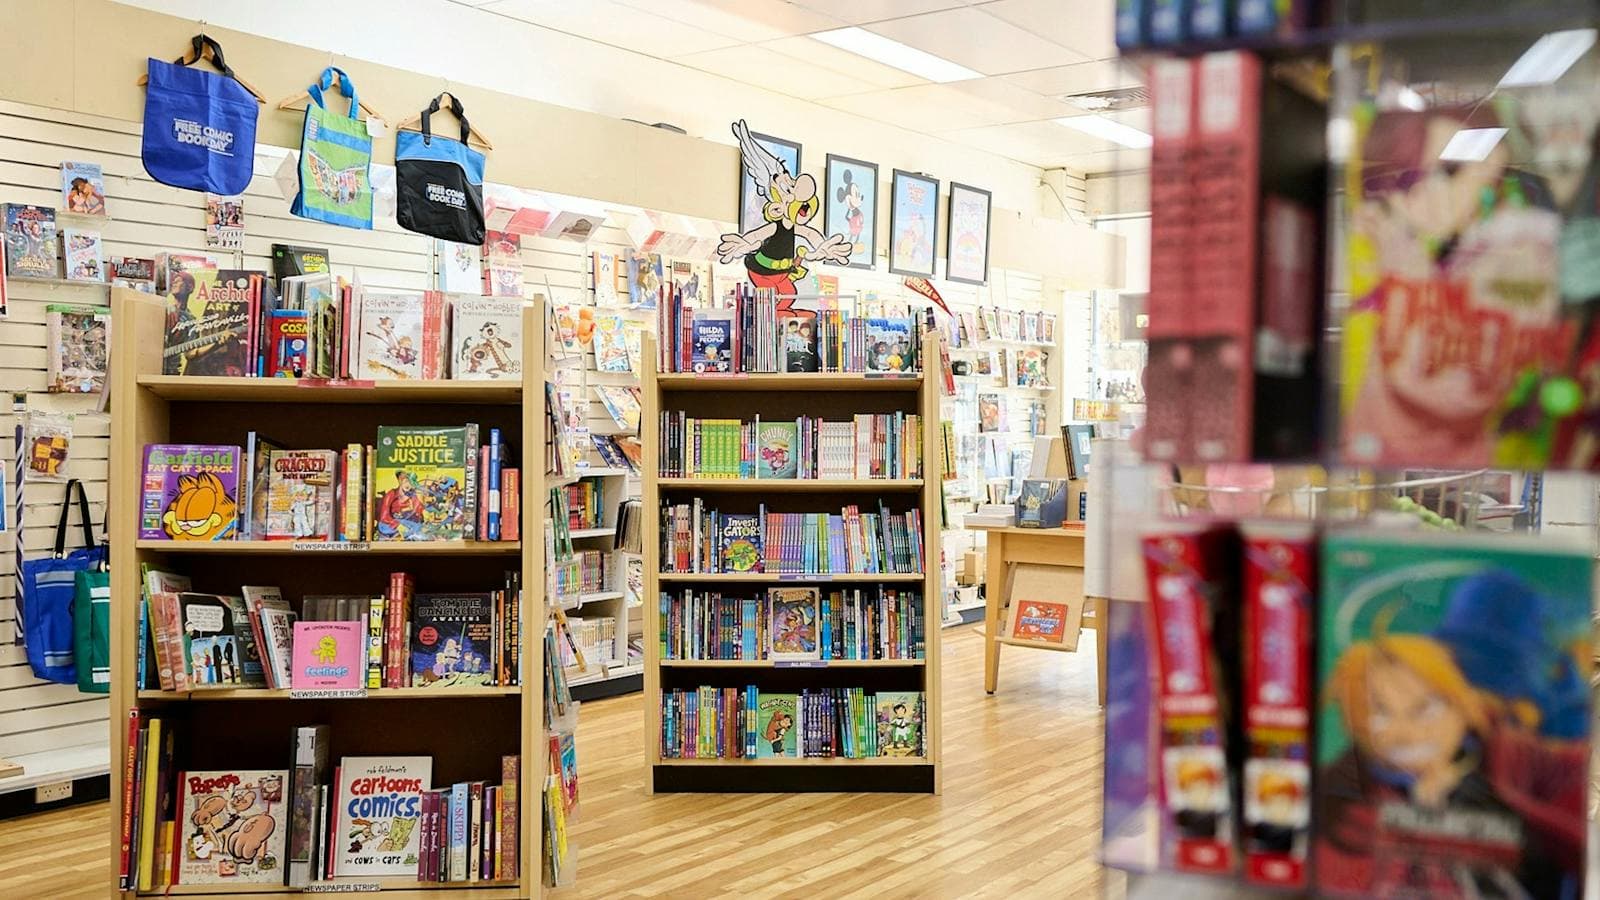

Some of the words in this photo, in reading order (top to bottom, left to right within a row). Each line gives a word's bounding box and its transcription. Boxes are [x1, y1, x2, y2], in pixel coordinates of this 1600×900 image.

[174, 121, 201, 135] FREE
[203, 126, 233, 143] COMIC
[178, 132, 210, 147] BOOK
[427, 185, 446, 195] FREE
[429, 193, 451, 203] BOOK
[207, 303, 231, 312] ART
[699, 326, 725, 334] HILDA
[760, 426, 793, 442] CHUNKY
[396, 435, 448, 447] SADDLE
[149, 450, 233, 465] Garfield
[388, 448, 455, 463] JUSTICE
[147, 464, 168, 473] FAT
[170, 464, 192, 473] CAT
[195, 464, 233, 473] 3-PACK
[275, 458, 326, 472] CRACKED
[727, 517, 758, 527] Investi
[723, 526, 760, 537] GATORS
[348, 793, 422, 818] comics.
[454, 807, 465, 844] SKIPPY
[353, 856, 374, 865] cows
[382, 856, 401, 865] cars
[304, 884, 351, 892] NEWSPAPER
